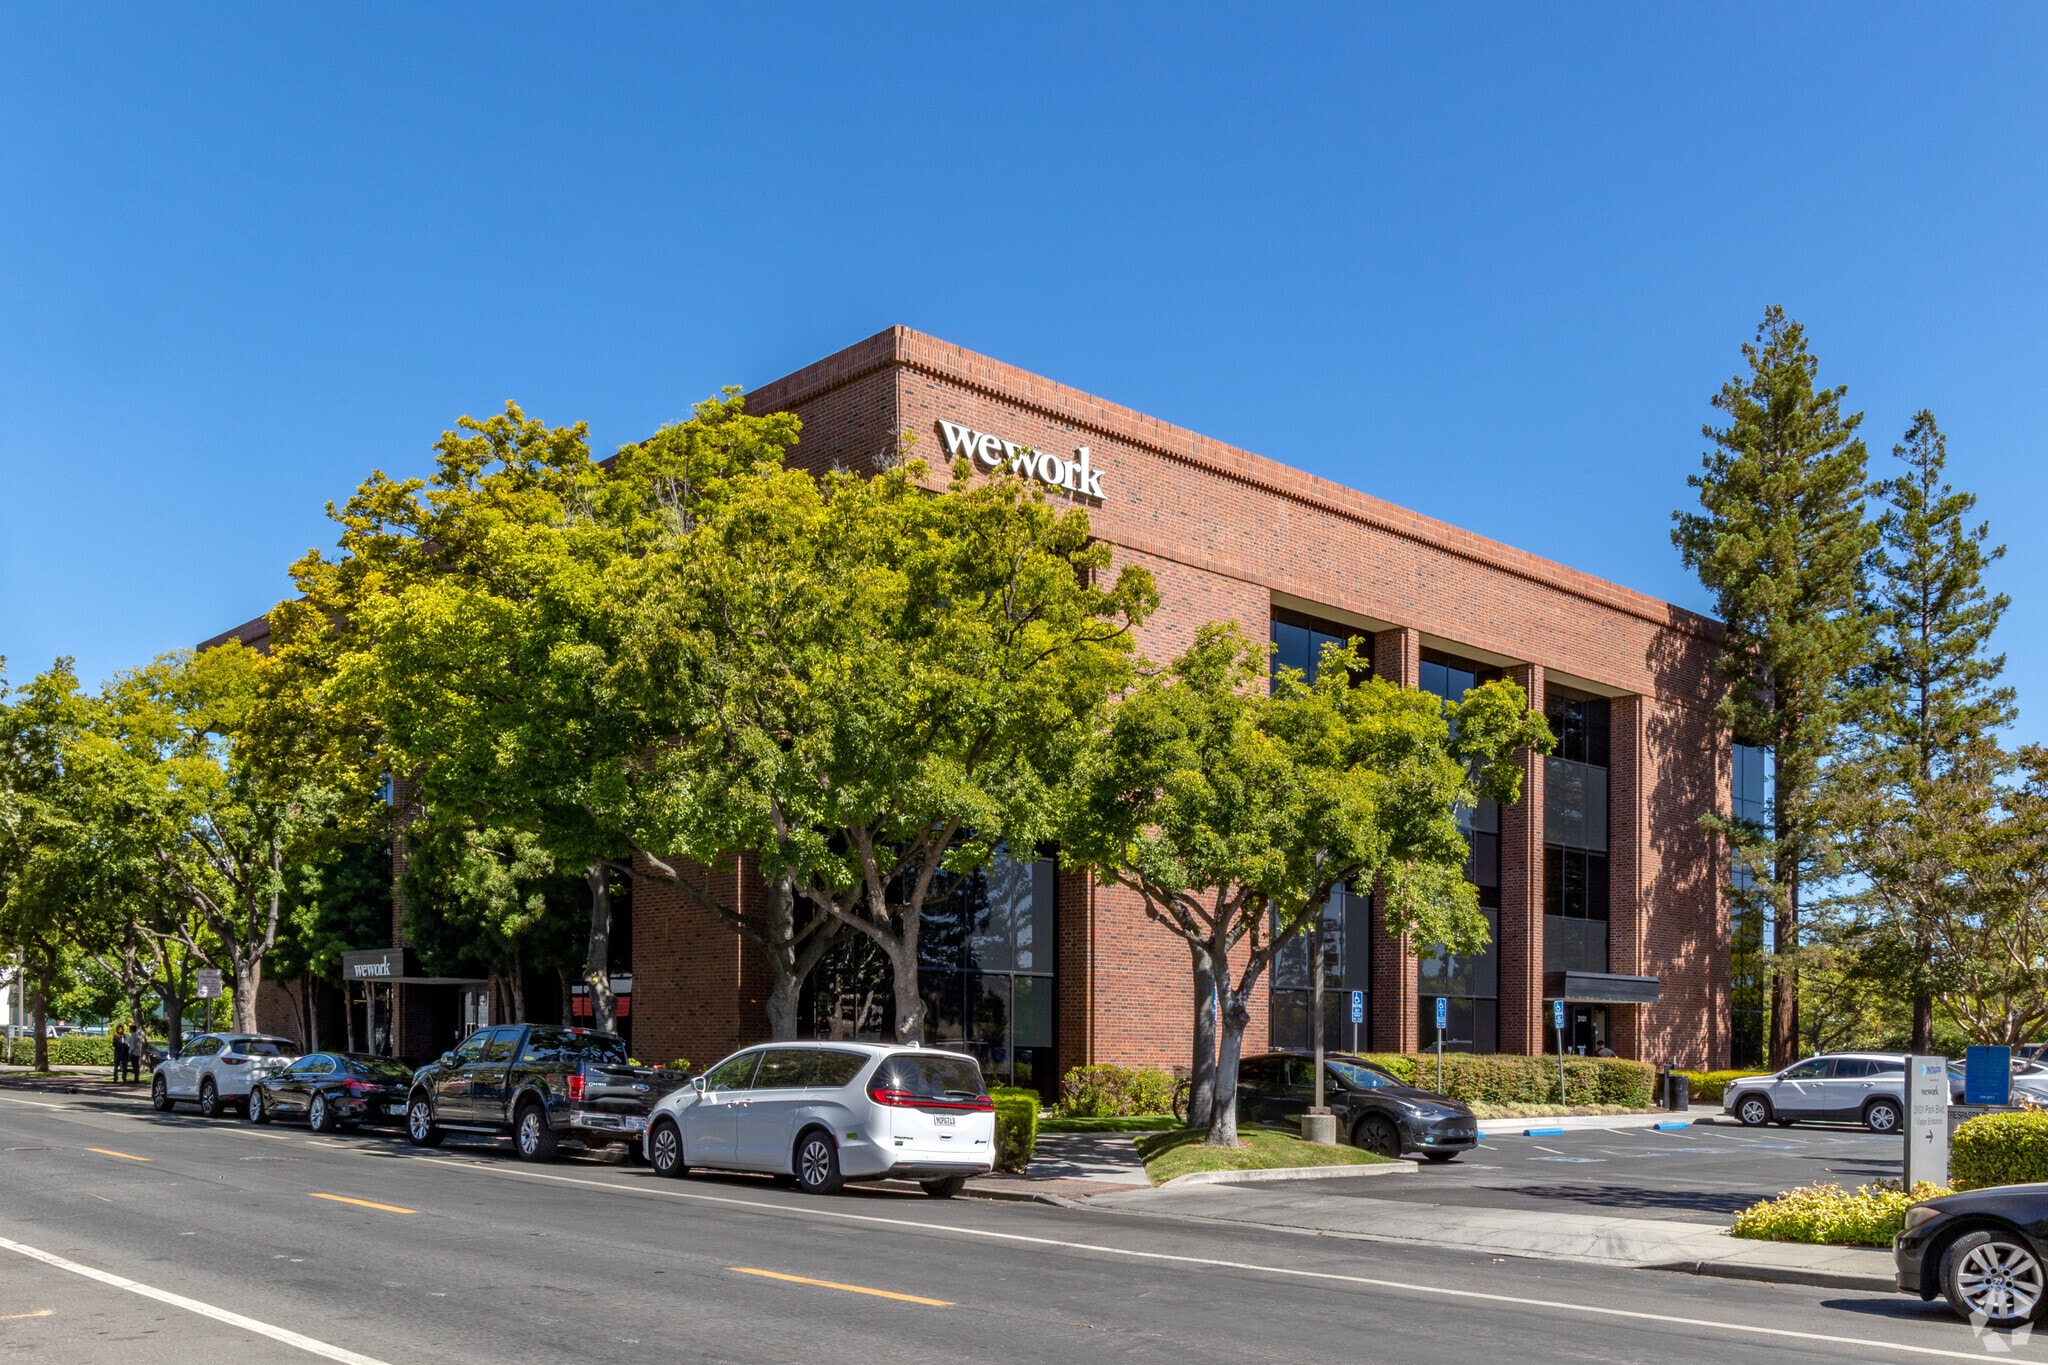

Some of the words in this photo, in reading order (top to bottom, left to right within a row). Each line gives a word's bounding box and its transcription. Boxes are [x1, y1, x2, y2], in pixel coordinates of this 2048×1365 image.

[938, 418, 1107, 500] wework
[354, 955, 391, 976] wework
[1921, 1086, 1939, 1096] wework
[1925, 1105, 1934, 1114] Park
[1935, 1105, 1945, 1114] Blvd
